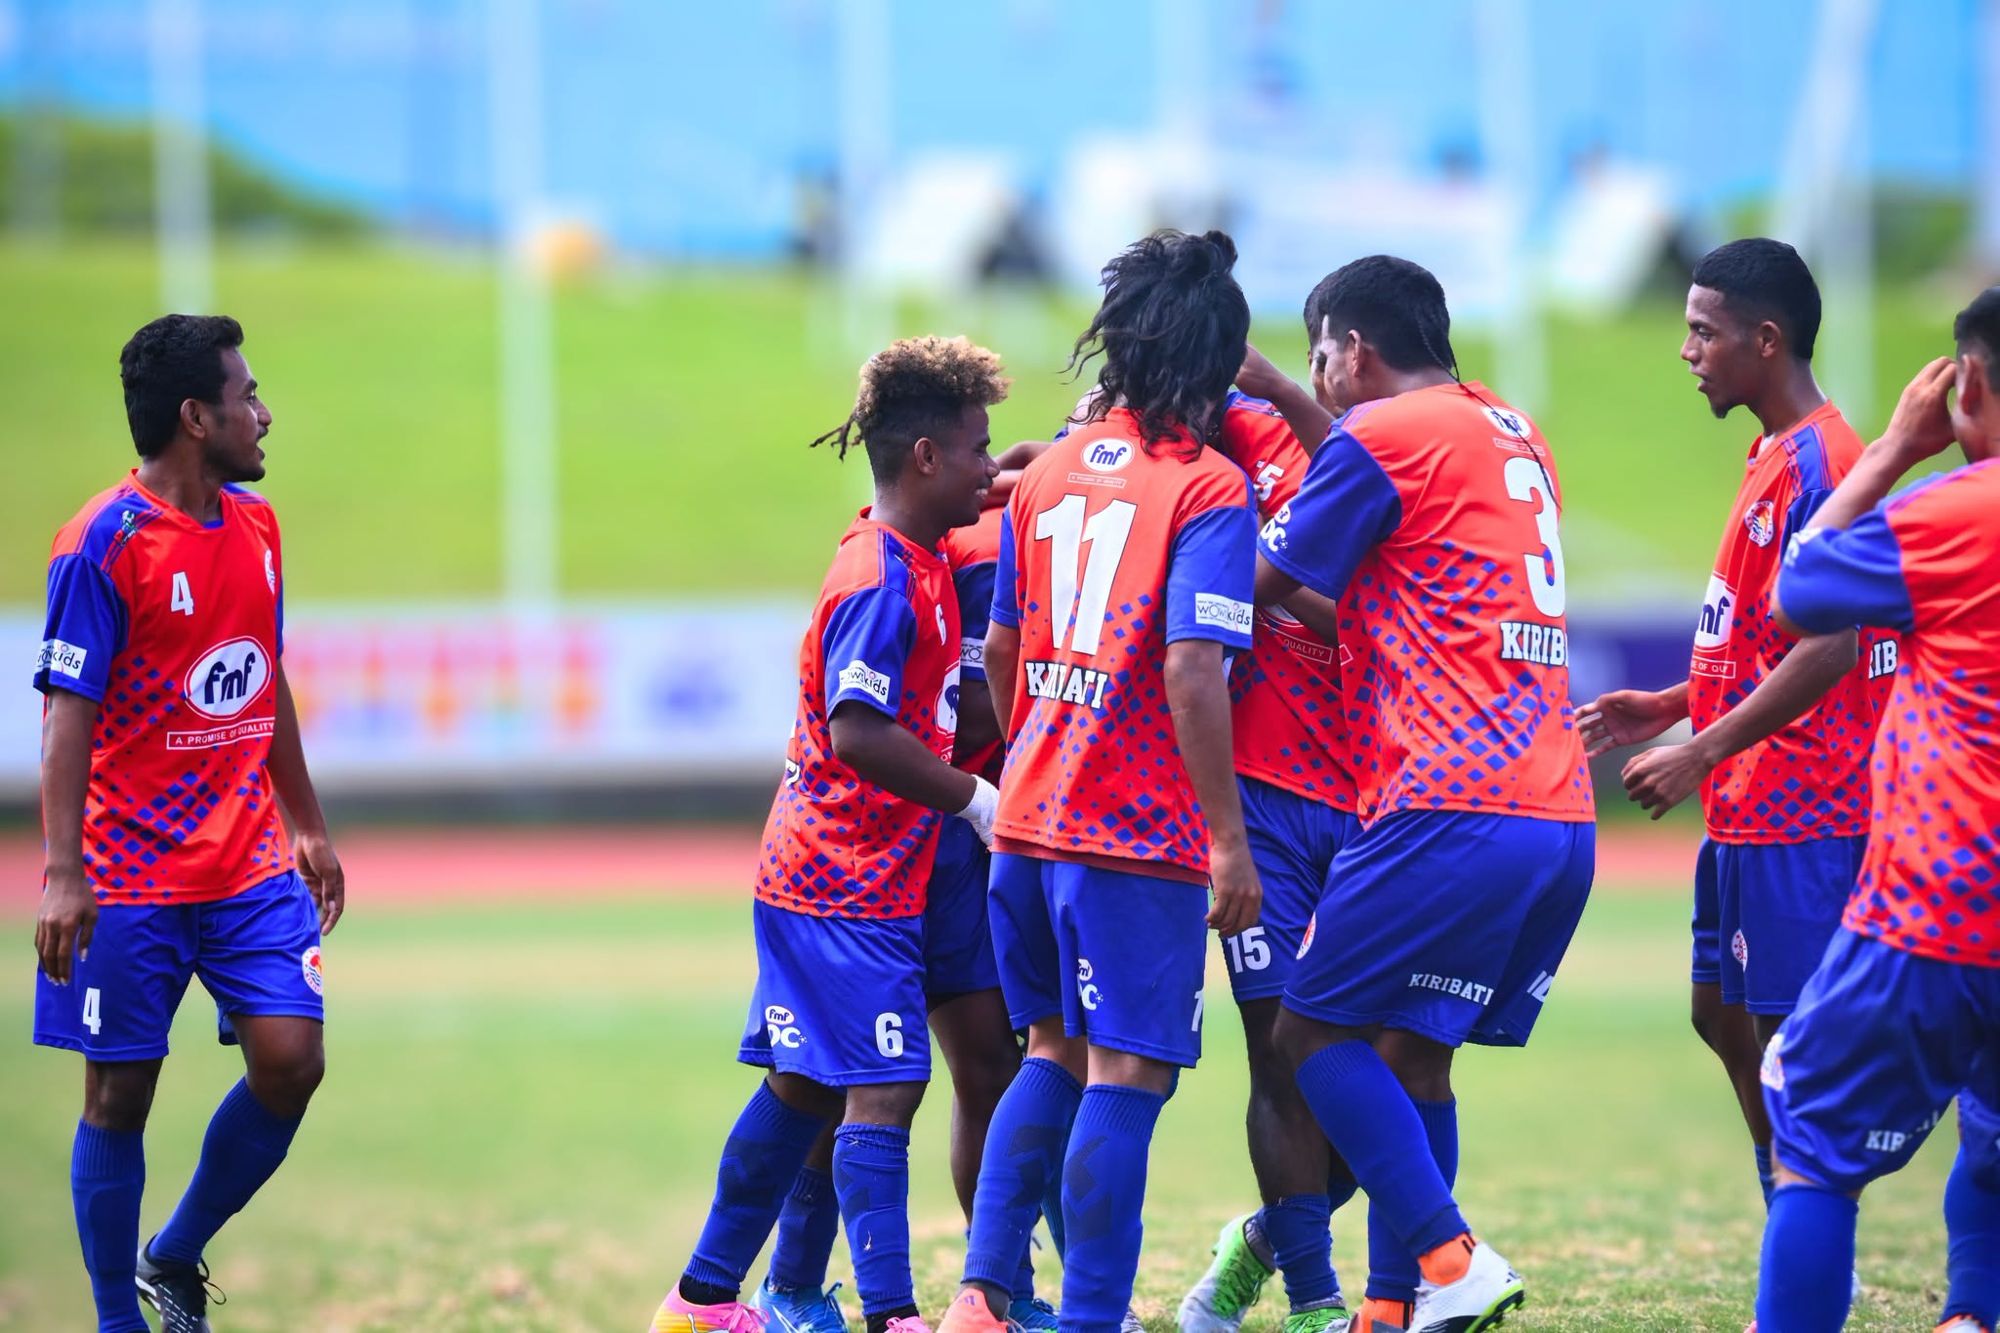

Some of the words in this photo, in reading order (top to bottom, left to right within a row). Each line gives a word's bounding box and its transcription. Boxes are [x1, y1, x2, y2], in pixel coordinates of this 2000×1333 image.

[1090, 443, 1127, 466] fmf
[1503, 456, 1566, 617] 3
[171, 571, 194, 616] 4
[1034, 493, 1138, 656] 11
[1499, 621, 1569, 668] KIRIB
[204, 651, 256, 704] fmf
[175, 736, 183, 745] A
[187, 731, 226, 745] PROMISE
[238, 722, 275, 735] QUALITY
[1227, 926, 1272, 974] 15
[83, 988, 102, 1035] 4
[1408, 973, 1495, 1006] KIRIBATI
[769, 1008, 790, 1022] fmf
[875, 1012, 904, 1058] 6
